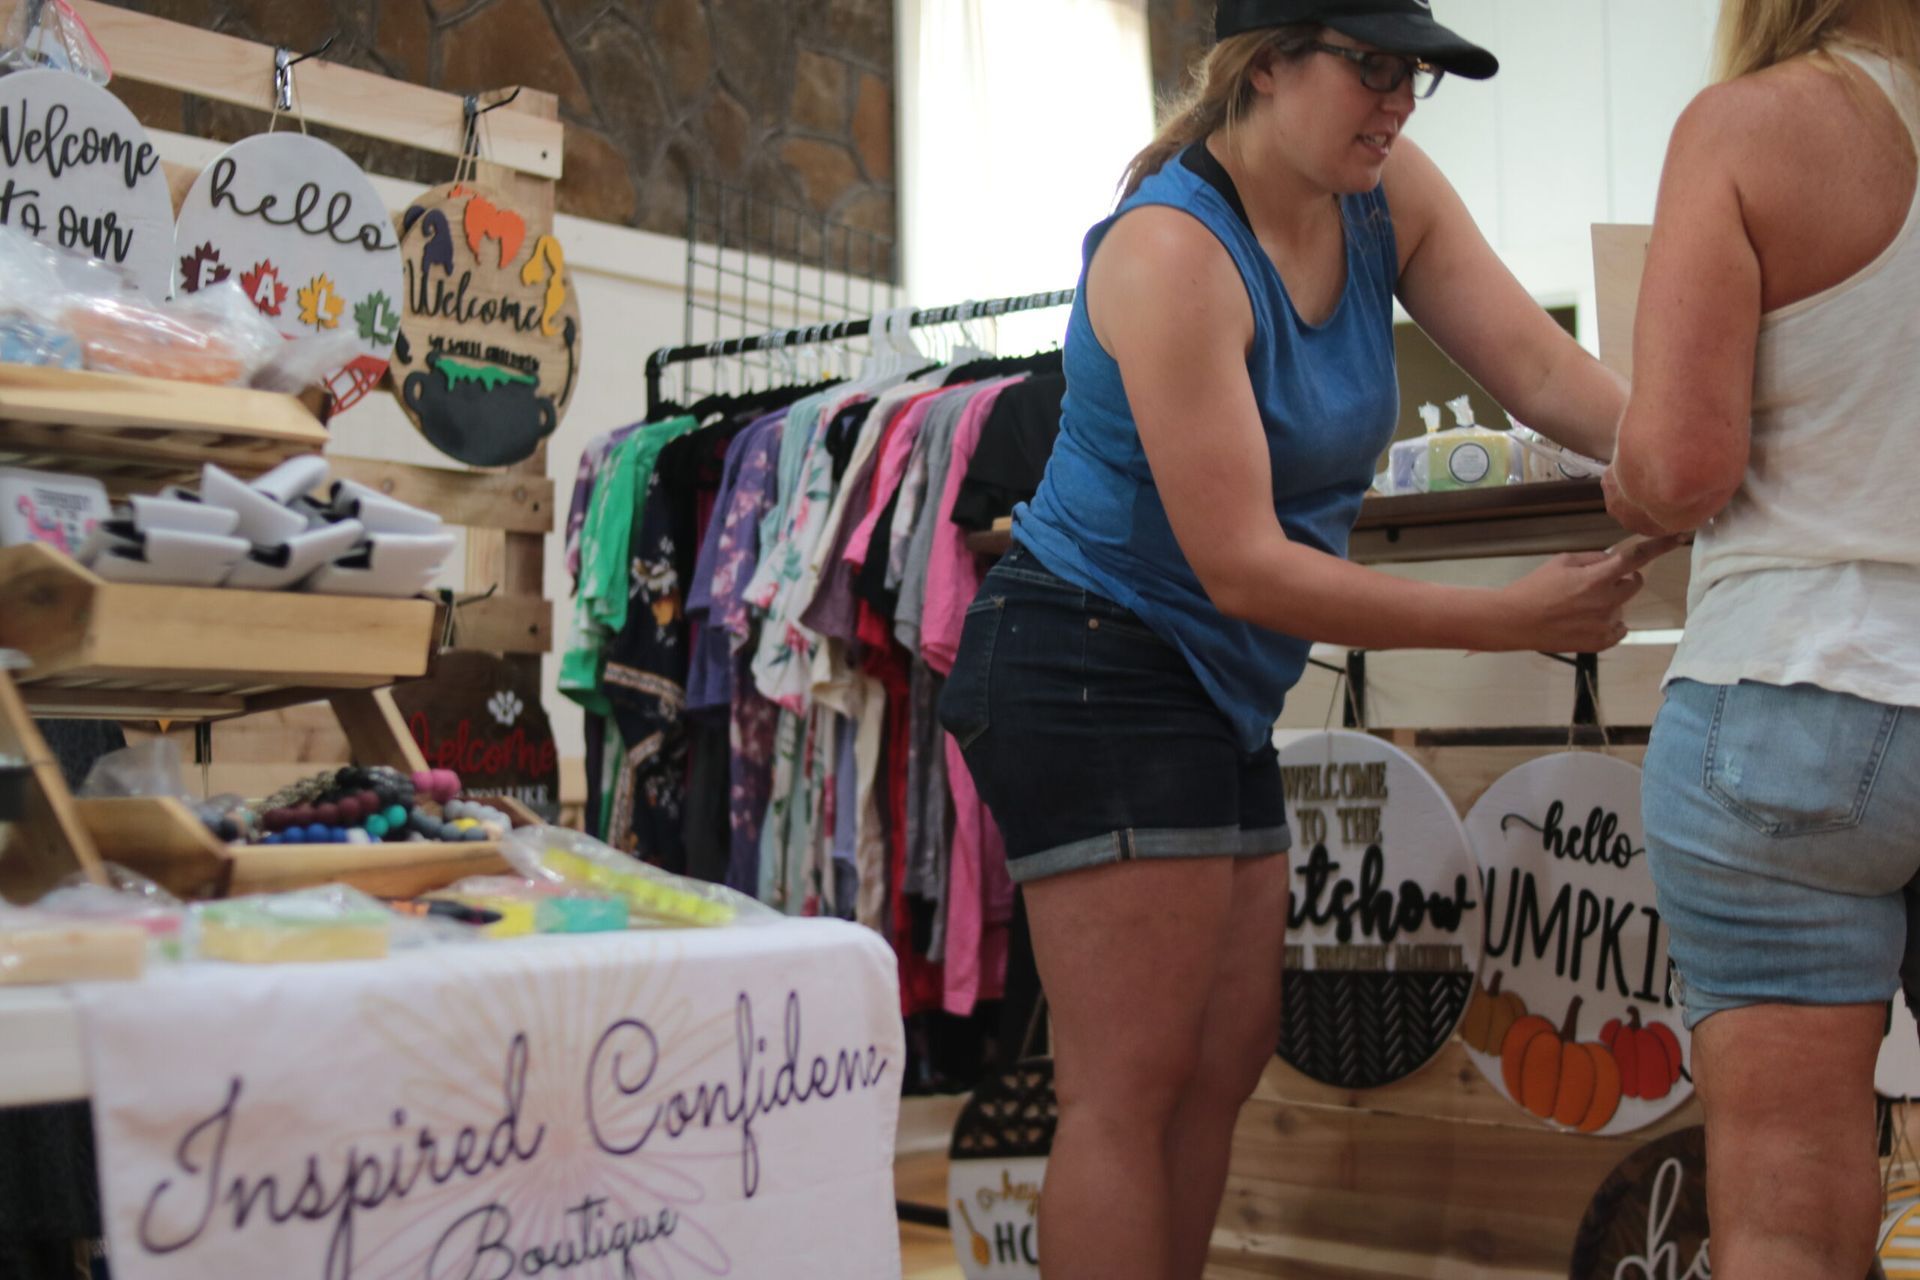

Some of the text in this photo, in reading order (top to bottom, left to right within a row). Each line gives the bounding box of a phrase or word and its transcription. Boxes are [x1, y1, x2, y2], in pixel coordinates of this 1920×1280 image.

[0, 179, 134, 263] to our
[210, 157, 398, 252] hello
[197, 258, 389, 336] FALL
[408, 257, 545, 334] Welcome
[1281, 761, 1388, 801] WELCOME
[1296, 806, 1383, 846] TO THE
[1501, 799, 1646, 869] hello
[1479, 865, 1677, 1008] UMPKI
[138, 1030, 546, 1280] Inspired
[427, 1195, 681, 1280] Boutique
